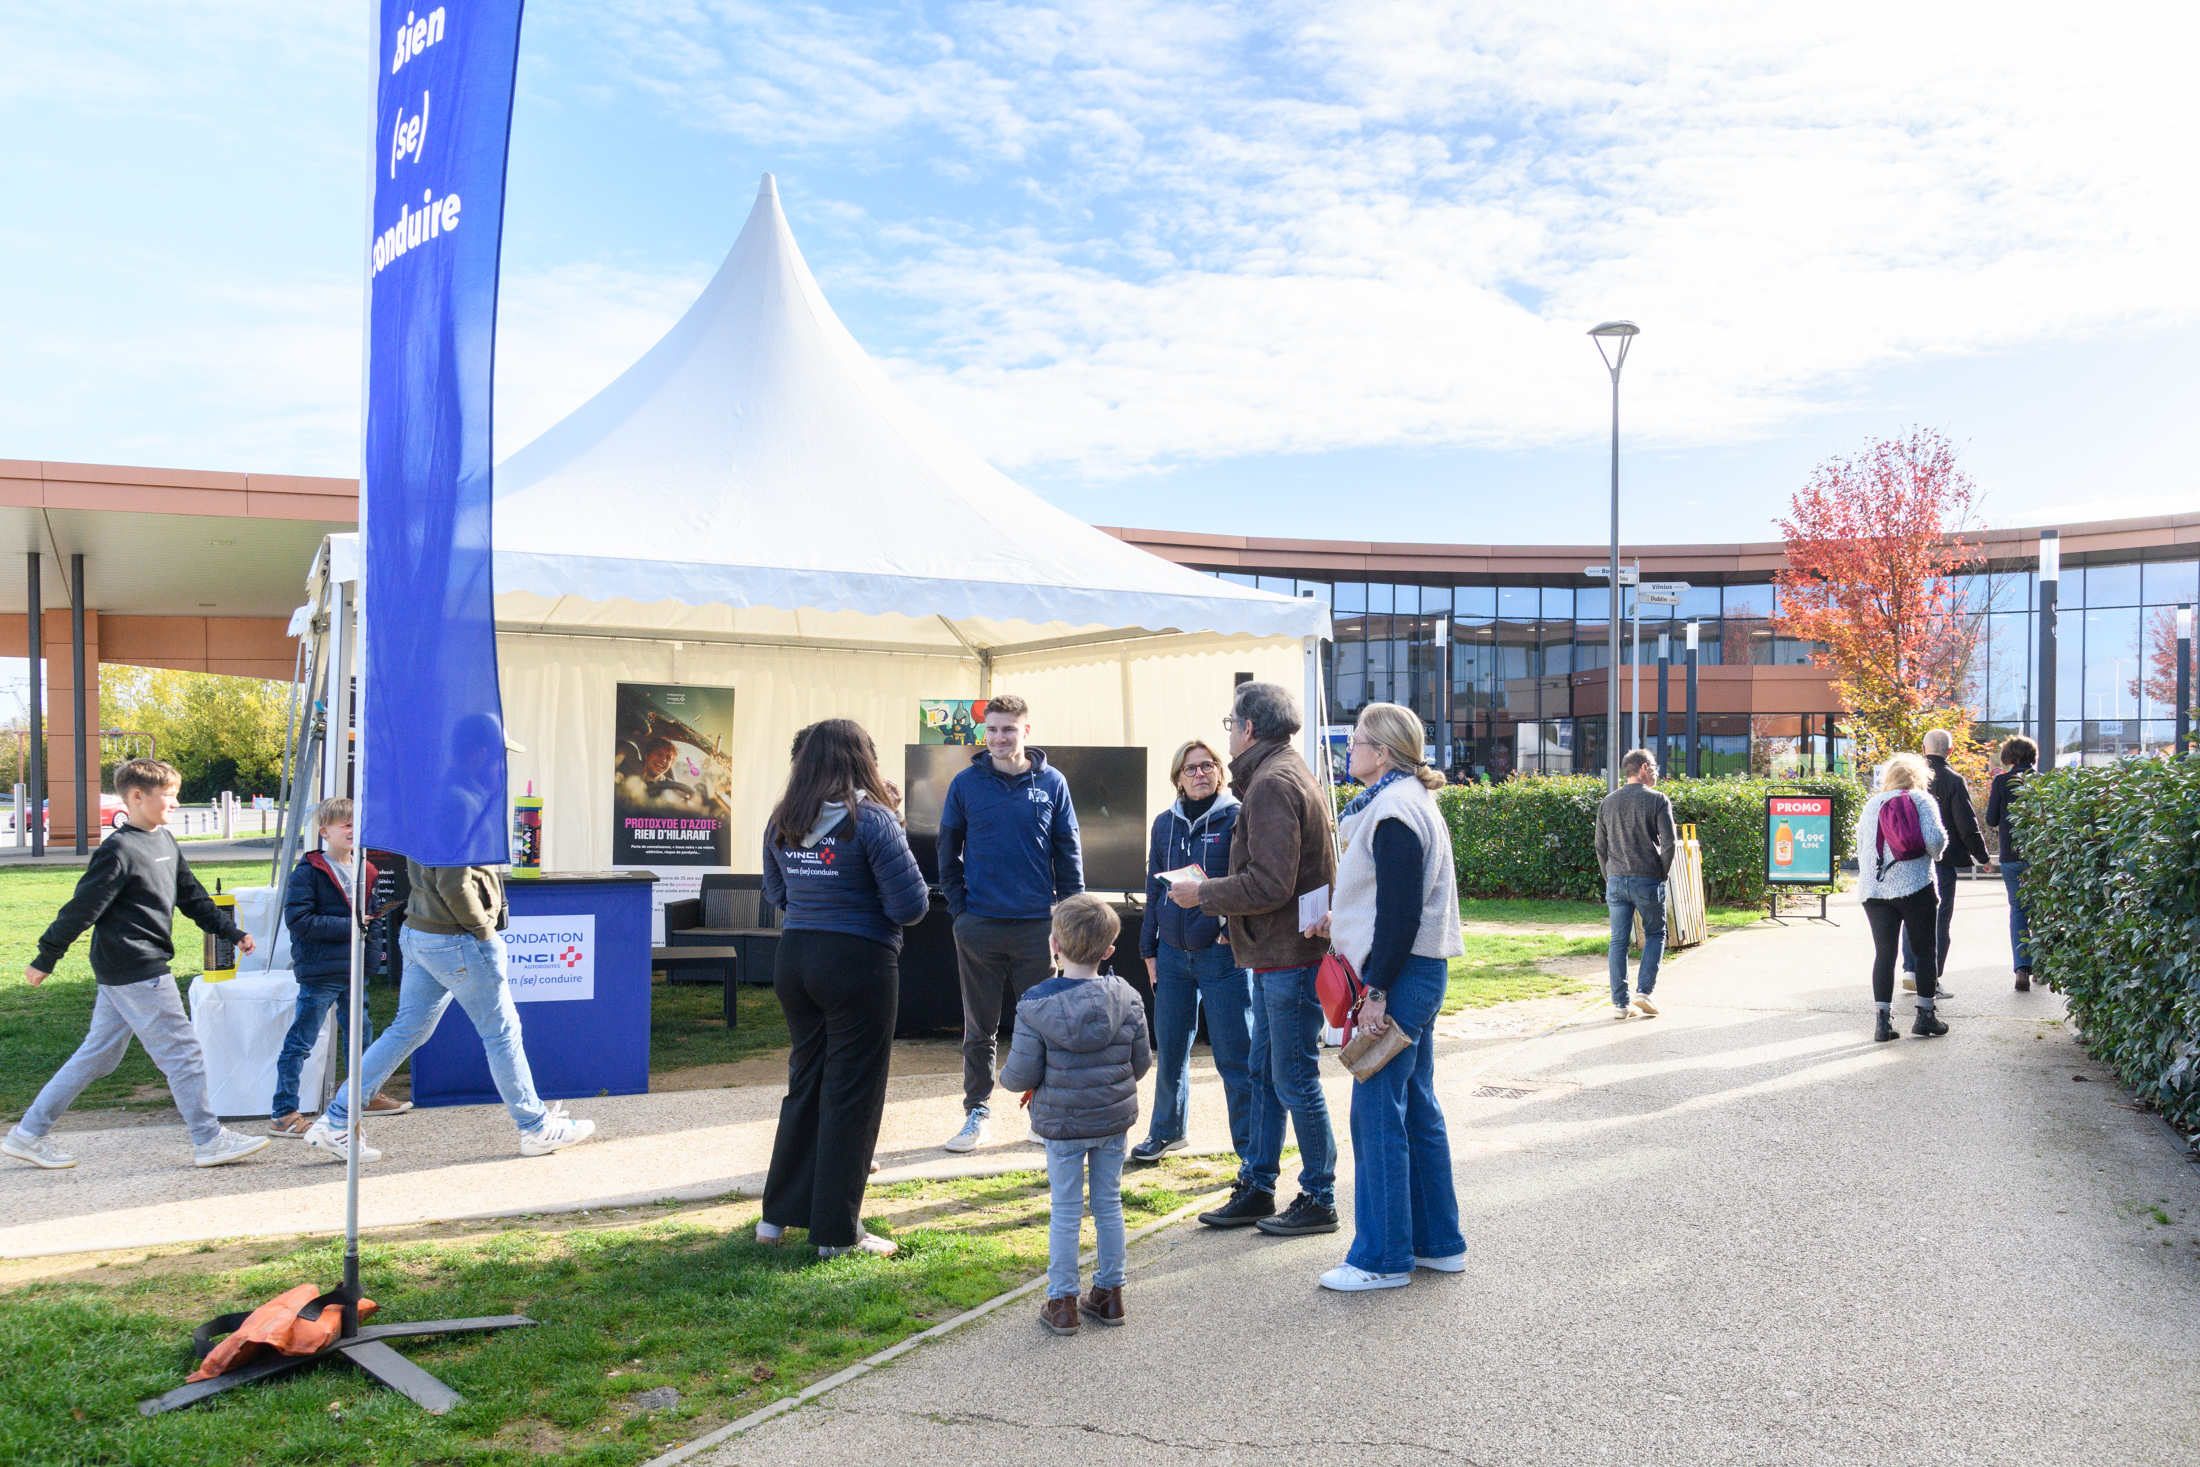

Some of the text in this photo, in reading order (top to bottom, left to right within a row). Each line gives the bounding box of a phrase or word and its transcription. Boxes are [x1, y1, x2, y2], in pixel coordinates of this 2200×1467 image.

[391, 90, 429, 179] (se)
[1776, 802, 1822, 812] PROMO
[625, 818, 678, 829] PROTOXYDE
[680, 819, 717, 830] D'AZOTE
[634, 829, 711, 841] RIEN D'HILARANT
[785, 851, 818, 859] VINCI
[810, 868, 839, 876] conduire
[508, 954, 554, 963] INCI
[520, 974, 538, 987] (se)
[539, 973, 583, 984] conduire
